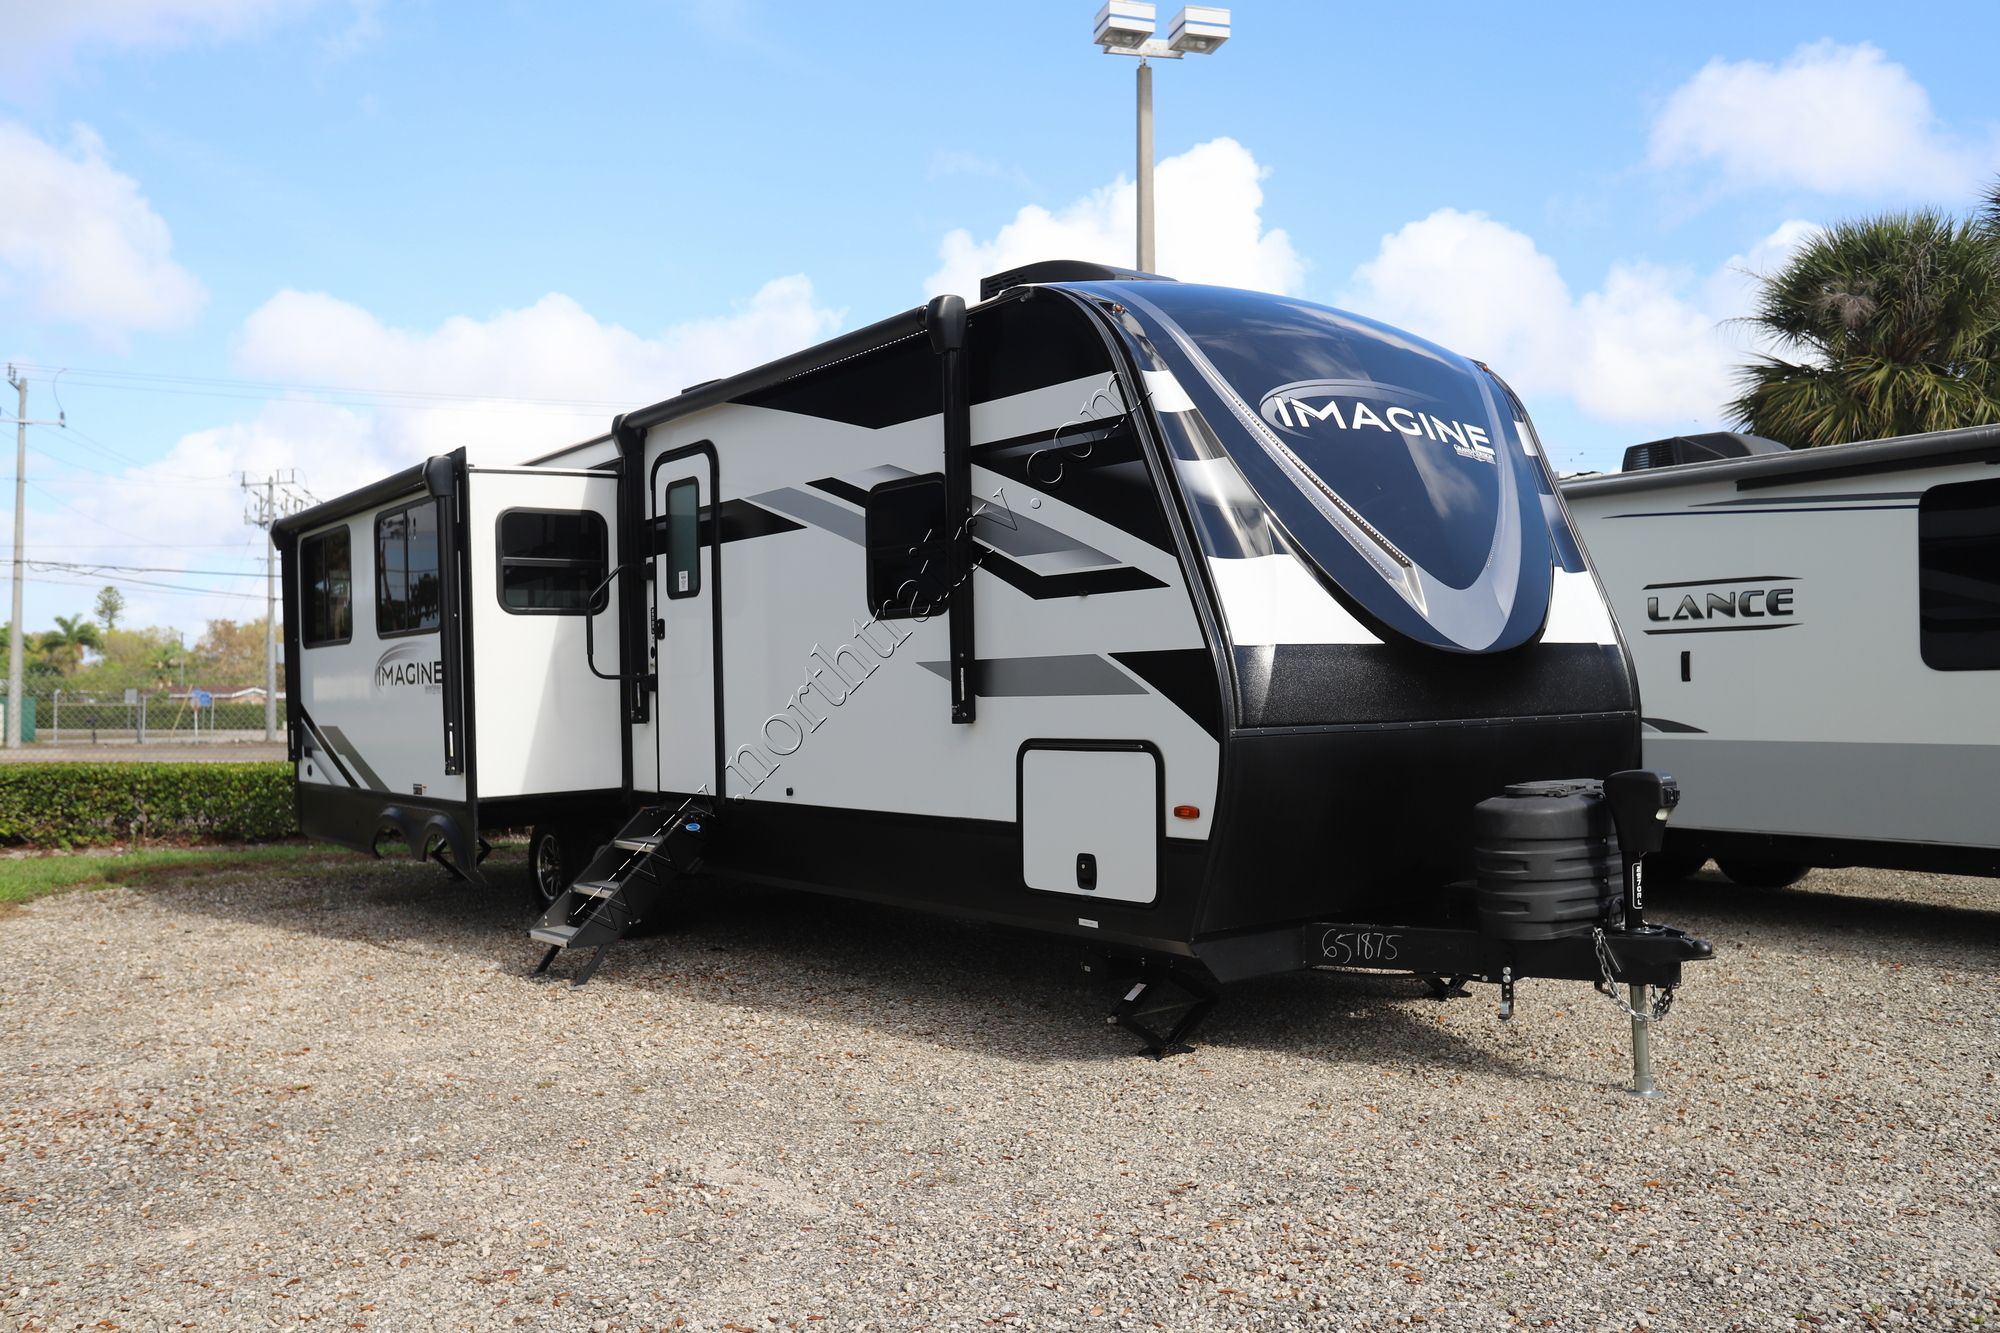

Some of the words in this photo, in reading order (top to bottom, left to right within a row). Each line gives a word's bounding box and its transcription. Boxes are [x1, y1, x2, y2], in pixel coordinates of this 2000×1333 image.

[1273, 396, 1496, 456] IMAGINE
[1647, 588, 1794, 622] LANCE
[377, 661, 443, 686] IMAGINE
[1321, 929, 1403, 964] 651875
